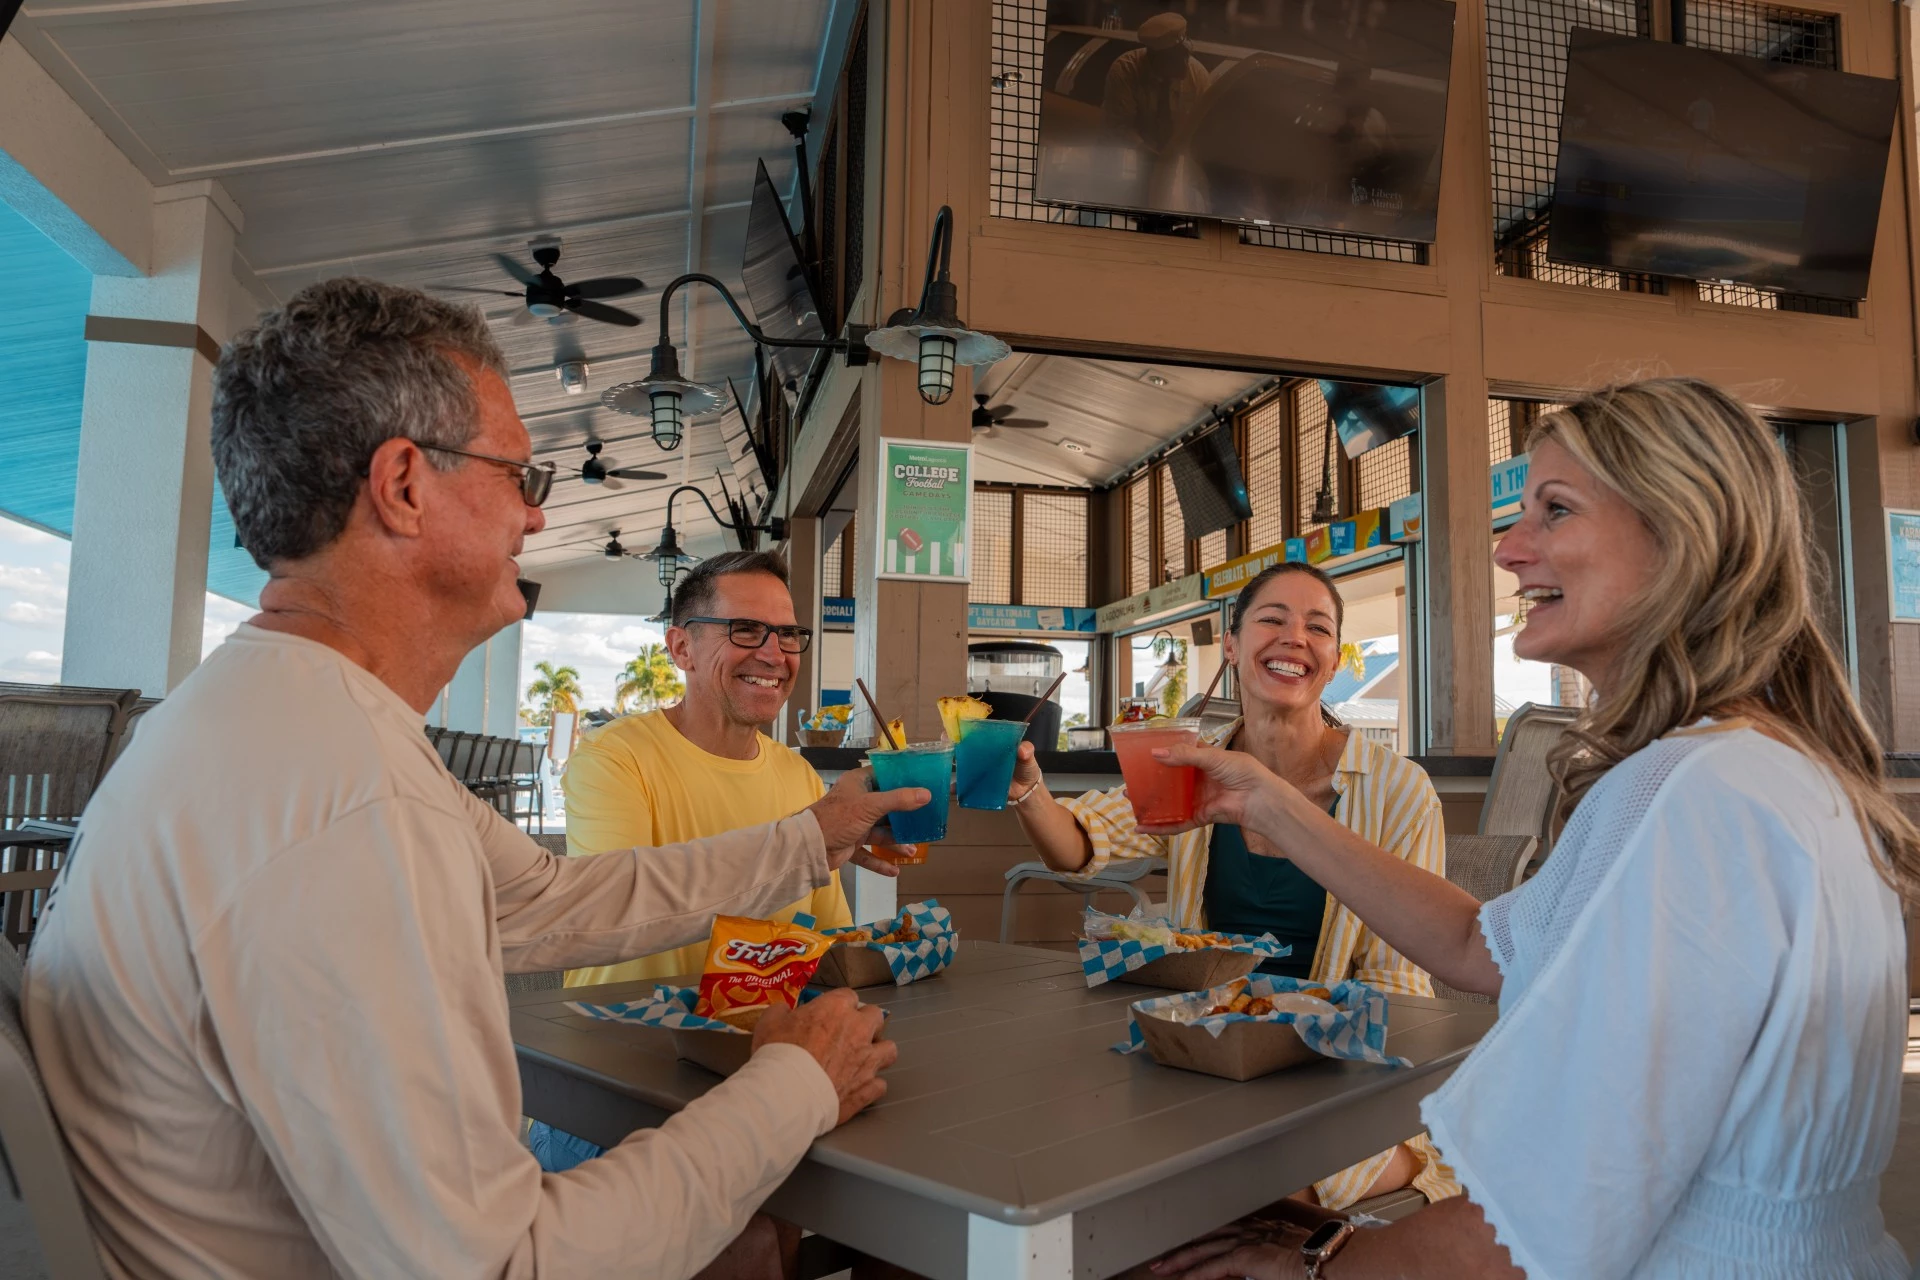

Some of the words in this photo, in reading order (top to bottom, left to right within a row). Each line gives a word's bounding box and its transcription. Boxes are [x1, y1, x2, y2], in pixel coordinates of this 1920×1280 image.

[1371, 187, 1402, 201] Liberty
[1370, 198, 1403, 210] Mutual
[894, 464, 959, 482] COLLEGE
[905, 477, 945, 489] Football
[903, 490, 951, 499] GAMEDAYS
[1899, 526, 1920, 538] KARA
[1212, 563, 1244, 588] CELEBRATE
[1244, 558, 1261, 578] YOUR
[1262, 551, 1279, 571] WAY
[981, 607, 995, 617] THE
[728, 975, 743, 984] The
[744, 967, 794, 985] ORIGINAL
